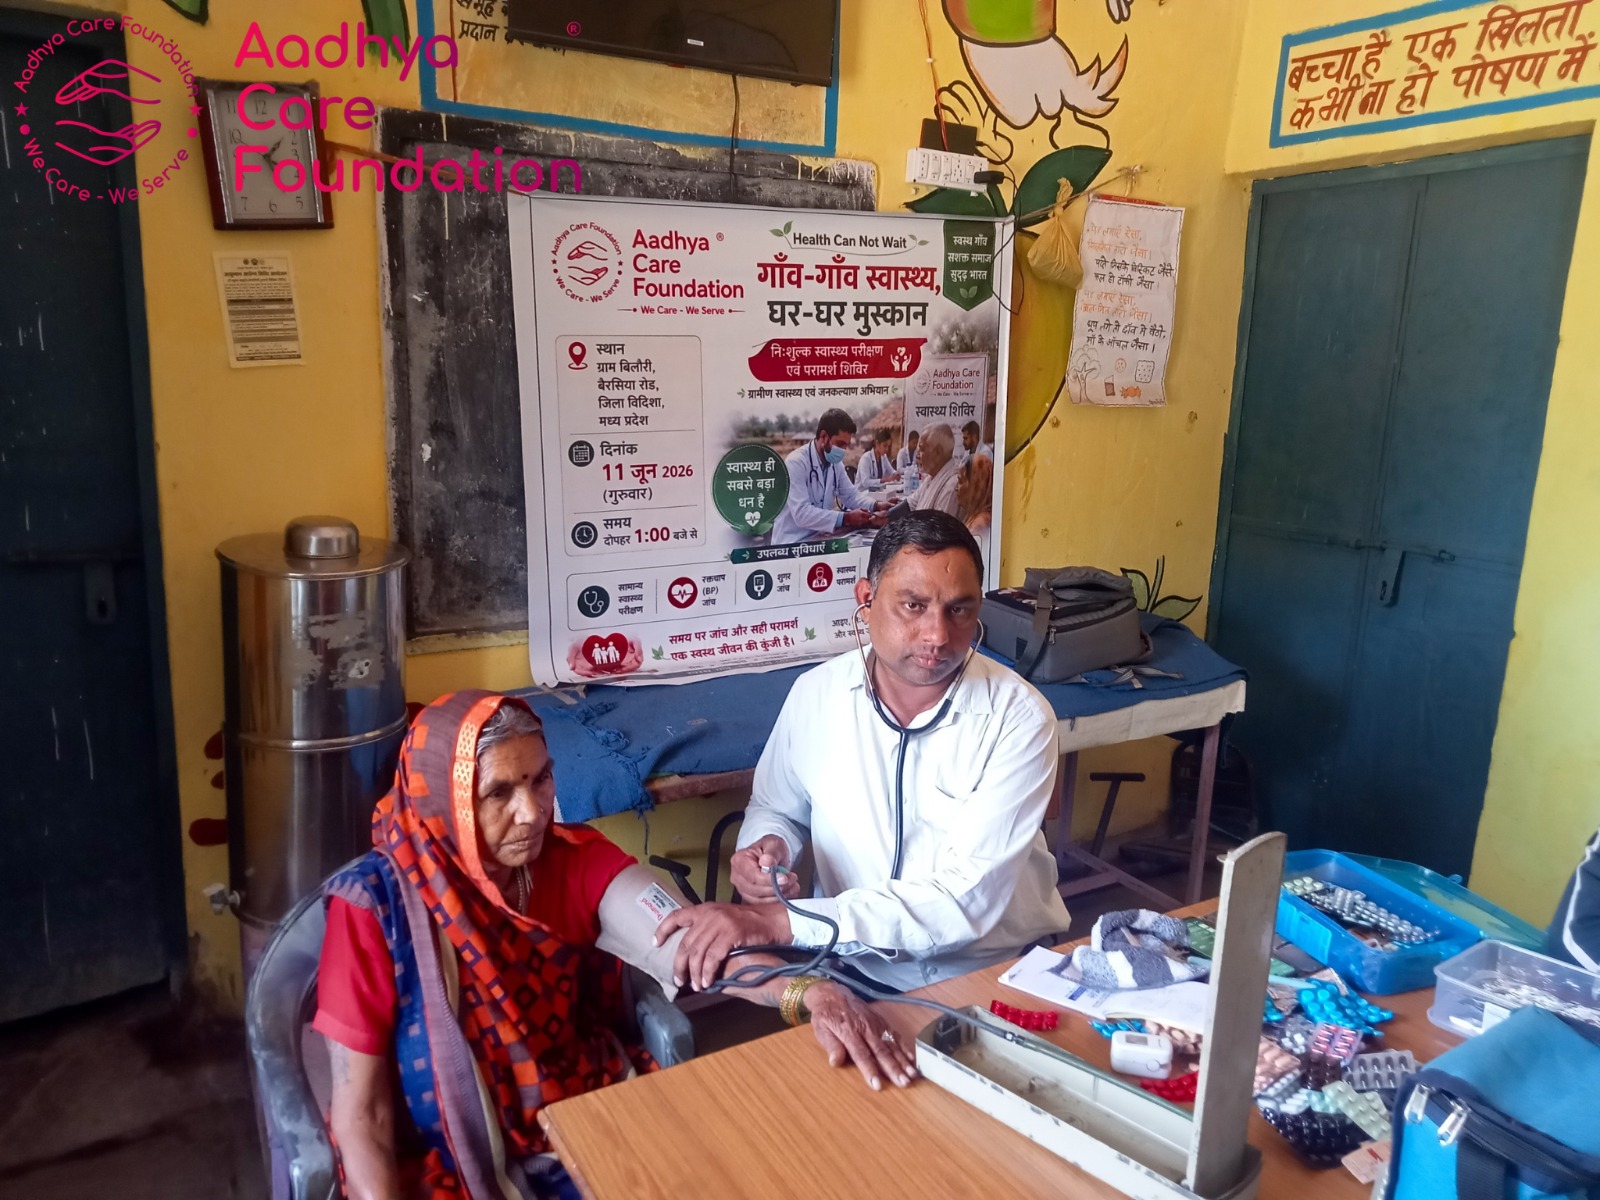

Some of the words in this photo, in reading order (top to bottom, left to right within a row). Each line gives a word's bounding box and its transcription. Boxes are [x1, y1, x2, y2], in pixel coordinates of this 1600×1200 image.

[458, 20, 499, 42] प्रदान
[1288, 46, 1362, 92] बच्चा
[1361, 29, 1392, 80] है
[1403, 22, 1468, 64] एक
[1476, 0, 1593, 52] खिलता
[1290, 73, 1363, 130] कभी
[1396, 63, 1439, 115] हो
[1451, 49, 1560, 98] पोषण
[1557, 31, 1598, 82] में
[241, 196, 248, 212] 7
[269, 200, 278, 213] 6
[296, 196, 304, 210] 5
[551, 229, 570, 256] Aadhya
[569, 222, 588, 231] Care
[589, 222, 622, 256] Foundation
[632, 229, 710, 255] Aadhya
[793, 233, 831, 246] Health
[833, 234, 856, 247] Can
[859, 236, 879, 248] Not
[881, 236, 907, 249] Wait
[953, 235, 973, 246] स्वस्थ
[632, 253, 681, 274] Care
[947, 252, 970, 263] सशक्त
[971, 253, 992, 263] समाज
[757, 251, 860, 290] गाँव-गाँव
[865, 265, 942, 296] स्वास्थ्य,
[969, 270, 987, 280] भारत
[555, 276, 566, 290] We
[565, 288, 584, 302] Care
[590, 294, 603, 303] We
[602, 278, 620, 298] Serve
[633, 277, 744, 299] Foundation
[640, 305, 655, 315] We
[657, 305, 678, 315] Care
[685, 306, 699, 315] We
[701, 306, 725, 315] Serve
[767, 301, 847, 327] घर-घर
[853, 302, 929, 337] मुस्कान
[596, 343, 625, 355] स्थान
[814, 345, 849, 358] स्वास्थ्य
[851, 342, 884, 357] परीक्षण
[596, 362, 616, 373] ग्राम
[786, 362, 801, 377] एवं
[803, 360, 838, 376] परामर्श
[840, 360, 869, 376] शिविर
[933, 368, 960, 379] Aadhya
[962, 368, 980, 377] Care
[639, 377, 659, 392] रोड,
[748, 386, 773, 399] ग्रामीण
[775, 389, 802, 399] स्वास्थ्य
[805, 386, 816, 397] एवं
[818, 386, 858, 397] जनकल्याण
[860, 384, 889, 396] अभियान
[932, 380, 974, 390] Foundation
[598, 395, 625, 409] जिला
[628, 395, 665, 409] विदिशा,
[915, 405, 947, 417] स्वास्थ्य
[949, 401, 976, 417] शिविर
[599, 416, 621, 427] मध्य
[624, 412, 649, 427] प्रदेश
[600, 441, 638, 457] दिनांक
[726, 461, 762, 474] स्वास्थ्य
[764, 457, 776, 473] ही
[602, 463, 624, 481] 11
[630, 463, 658, 484] जून
[662, 465, 694, 478] 2026
[726, 476, 753, 491] सबसे
[756, 477, 775, 491] बड़ा
[603, 487, 653, 505] (गुरुवार)
[738, 497, 754, 508] धन
[757, 493, 765, 508] है
[603, 517, 632, 530] समय
[603, 534, 631, 546] दोपहर
[635, 527, 670, 543] 1:00
[673, 529, 688, 540] बजे
[689, 527, 698, 539] से
[756, 547, 789, 559] उपलब्ध
[777, 572, 791, 582] शुगर
[836, 576, 856, 586] परामर्श
[618, 582, 643, 591] सामान्य
[702, 586, 719, 596] (BP)
[777, 583, 790, 593] जांच
[618, 594, 643, 603] स्वास्थ्य
[618, 605, 643, 615] परीक्षण
[669, 632, 692, 645] समय
[694, 631, 706, 641] पर
[709, 625, 728, 639] जांच
[732, 624, 748, 637] और
[750, 621, 768, 634] सही
[770, 616, 799, 631] परामर्श
[834, 629, 846, 638] और
[670, 650, 687, 661] एक
[690, 646, 715, 658] स्वस्थ
[717, 643, 743, 655] जीवन
[746, 639, 758, 651] की
[760, 636, 782, 651] कुंजी
